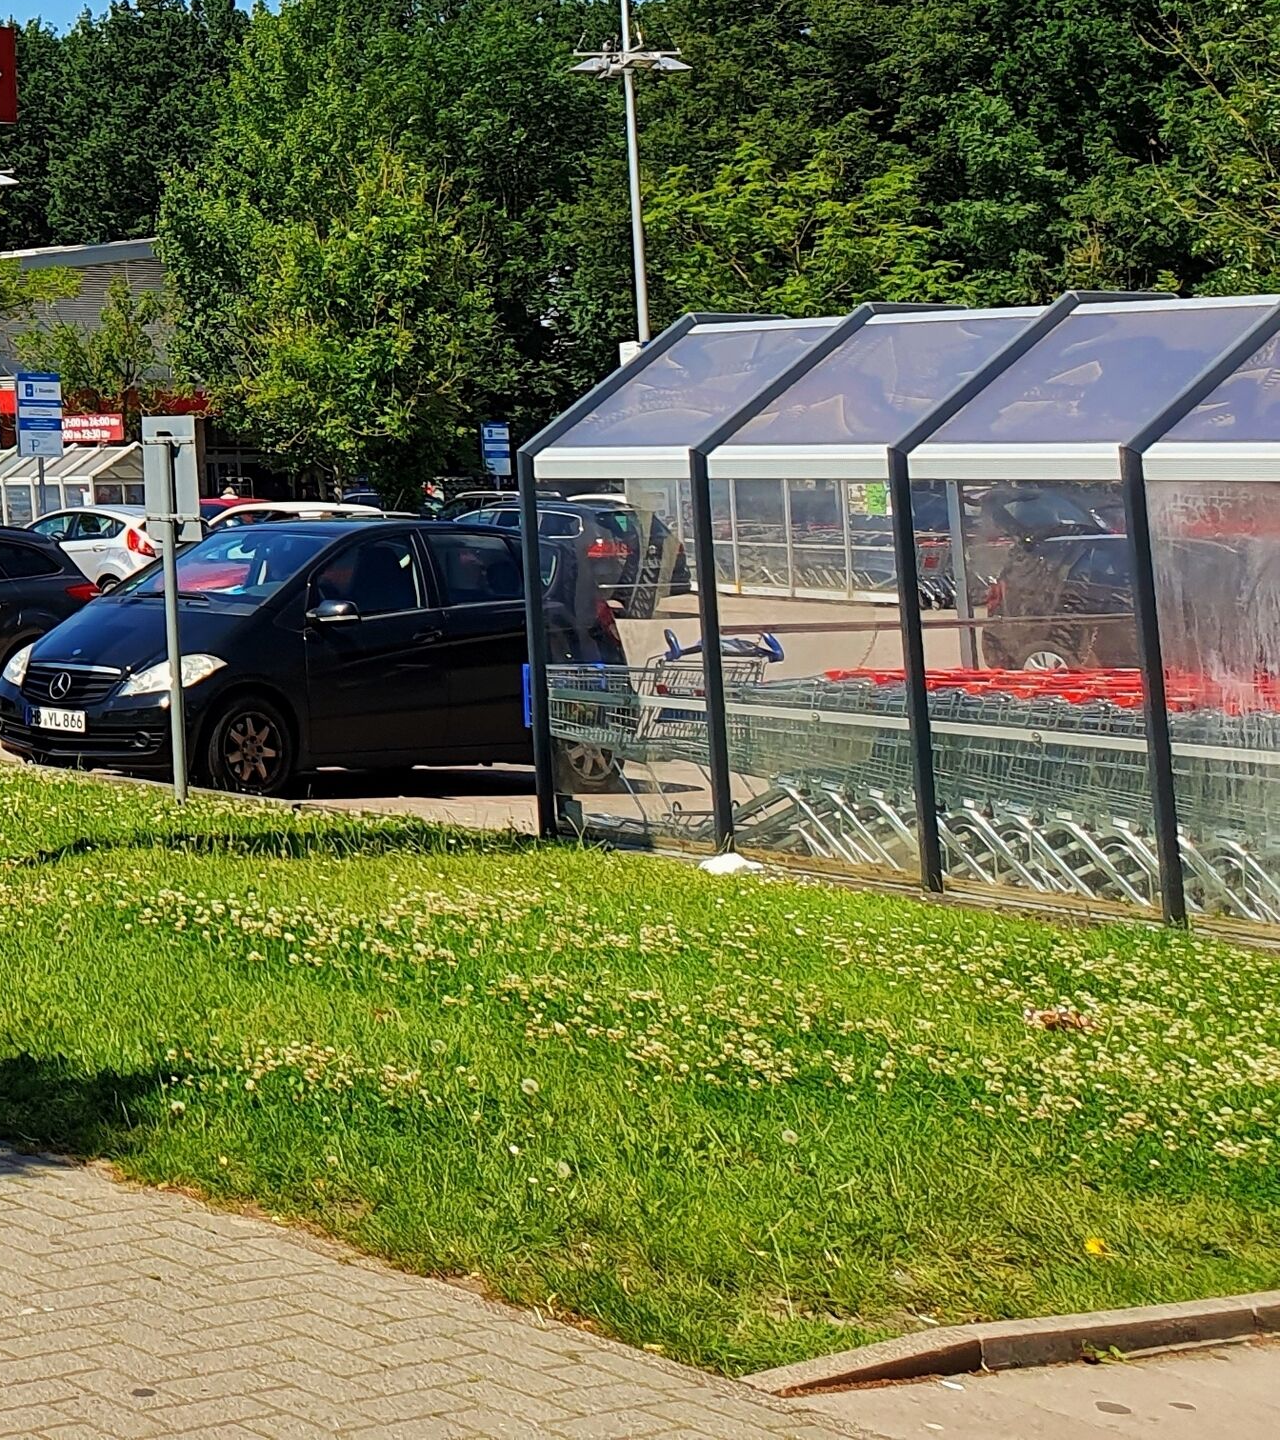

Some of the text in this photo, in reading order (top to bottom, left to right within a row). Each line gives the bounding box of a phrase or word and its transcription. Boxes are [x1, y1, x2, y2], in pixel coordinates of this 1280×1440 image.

[62, 430, 73, 439] :00
[48, 712, 60, 726] YL
[63, 713, 82, 728] 866
